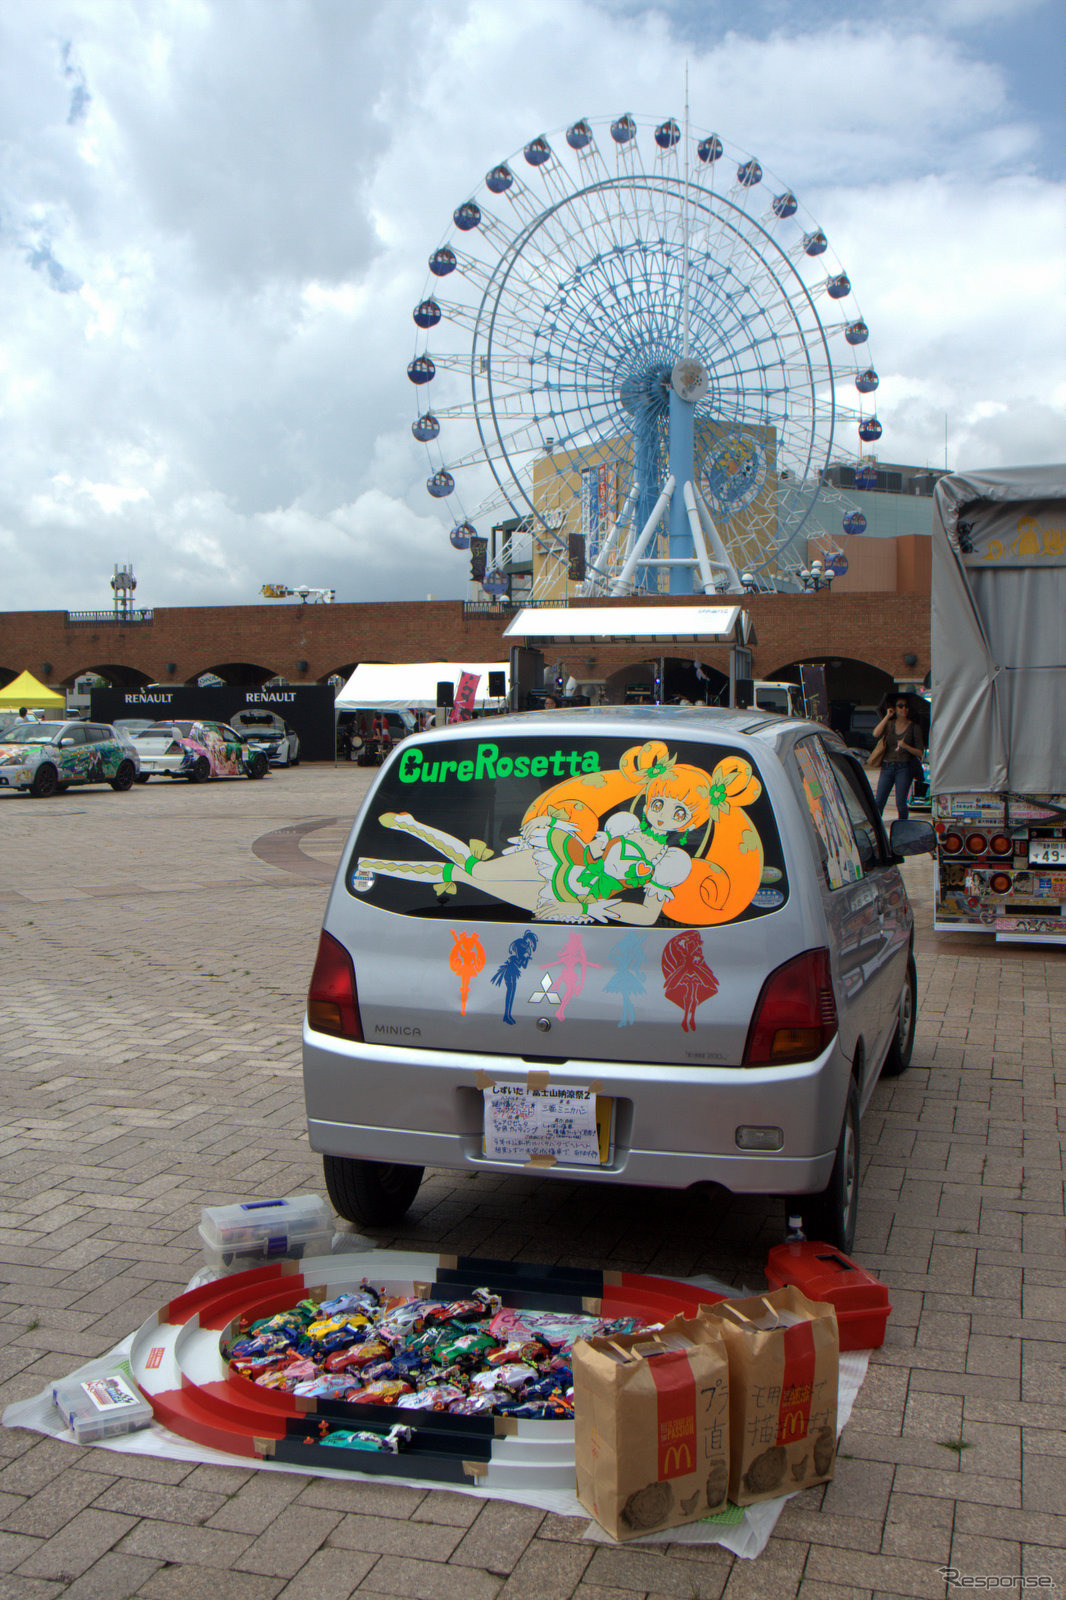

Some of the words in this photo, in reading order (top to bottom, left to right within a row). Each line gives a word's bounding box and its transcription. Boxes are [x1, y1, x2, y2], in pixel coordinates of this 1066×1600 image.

[124, 693, 173, 704] RENAULT
[246, 692, 296, 703] RENAULT
[398, 743, 600, 783] CureRosetta
[374, 1024, 422, 1036] MINICA
[704, 1416, 727, 1459] 直
